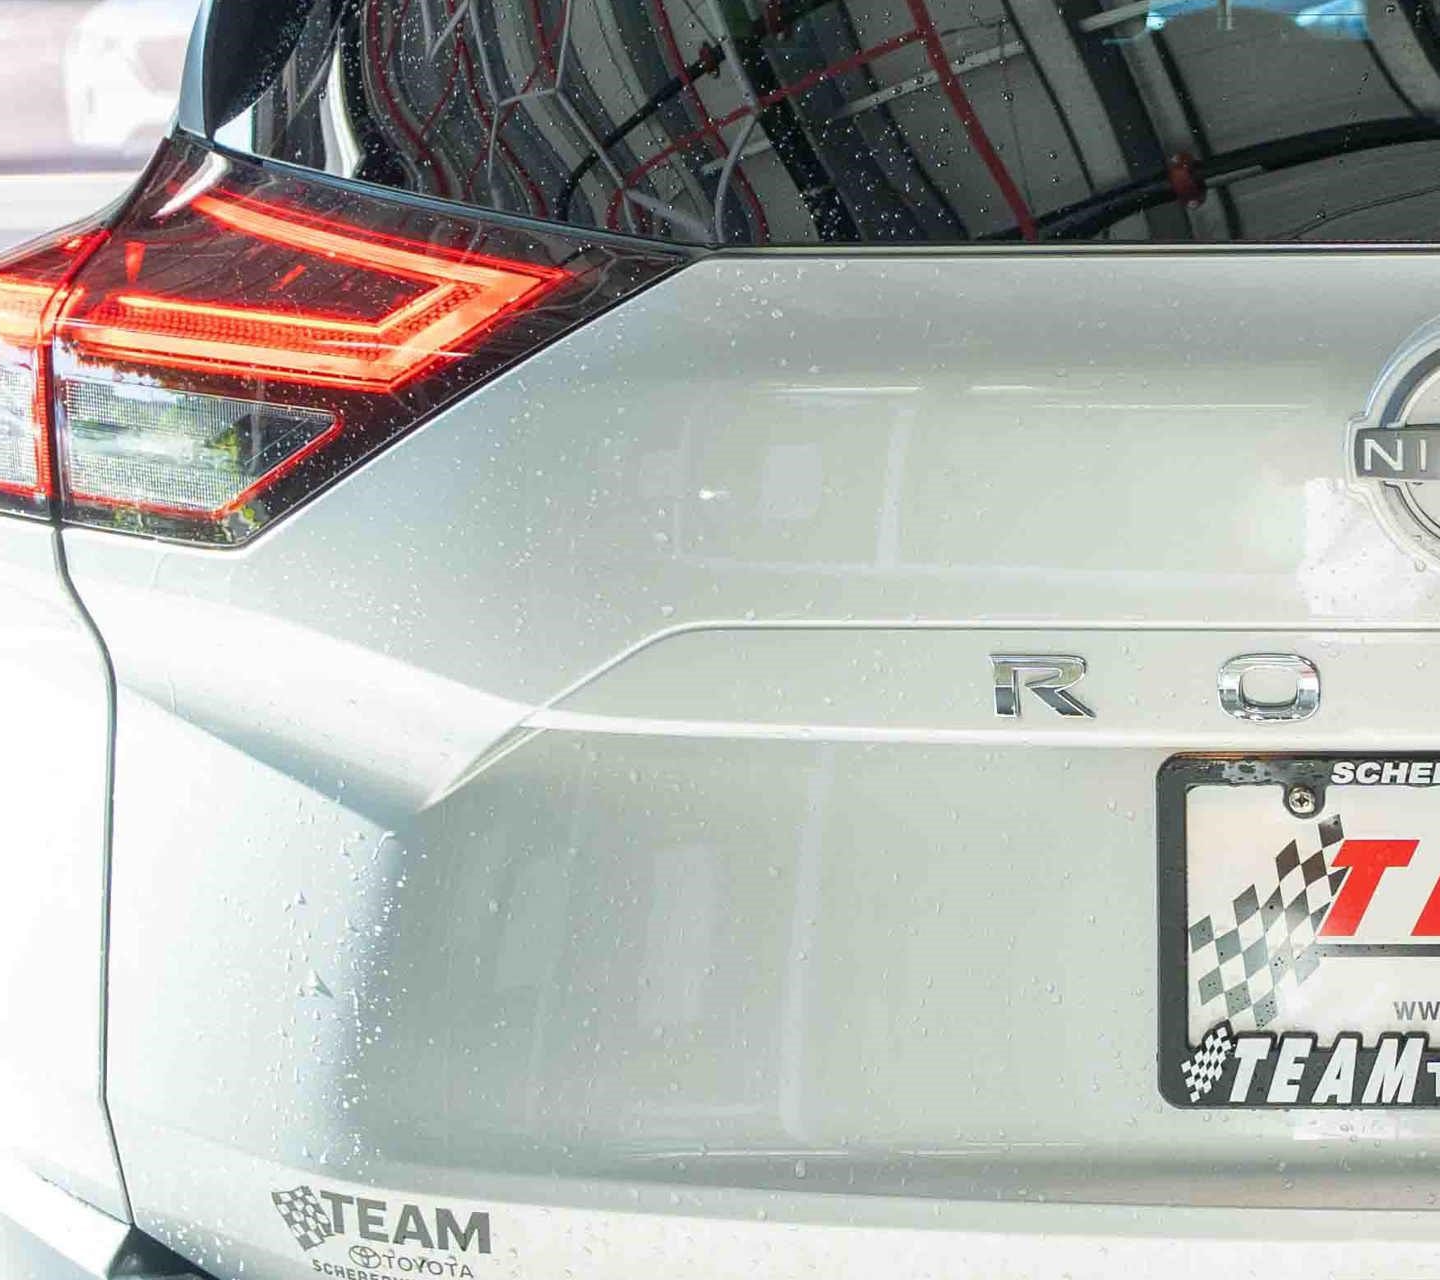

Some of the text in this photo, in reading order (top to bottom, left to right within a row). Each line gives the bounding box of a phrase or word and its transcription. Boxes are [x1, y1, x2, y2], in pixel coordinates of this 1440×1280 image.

[1228, 1037, 1428, 1105] TEAM
[320, 1189, 492, 1255] TEAM
[384, 1253, 473, 1278] TOYOTA
